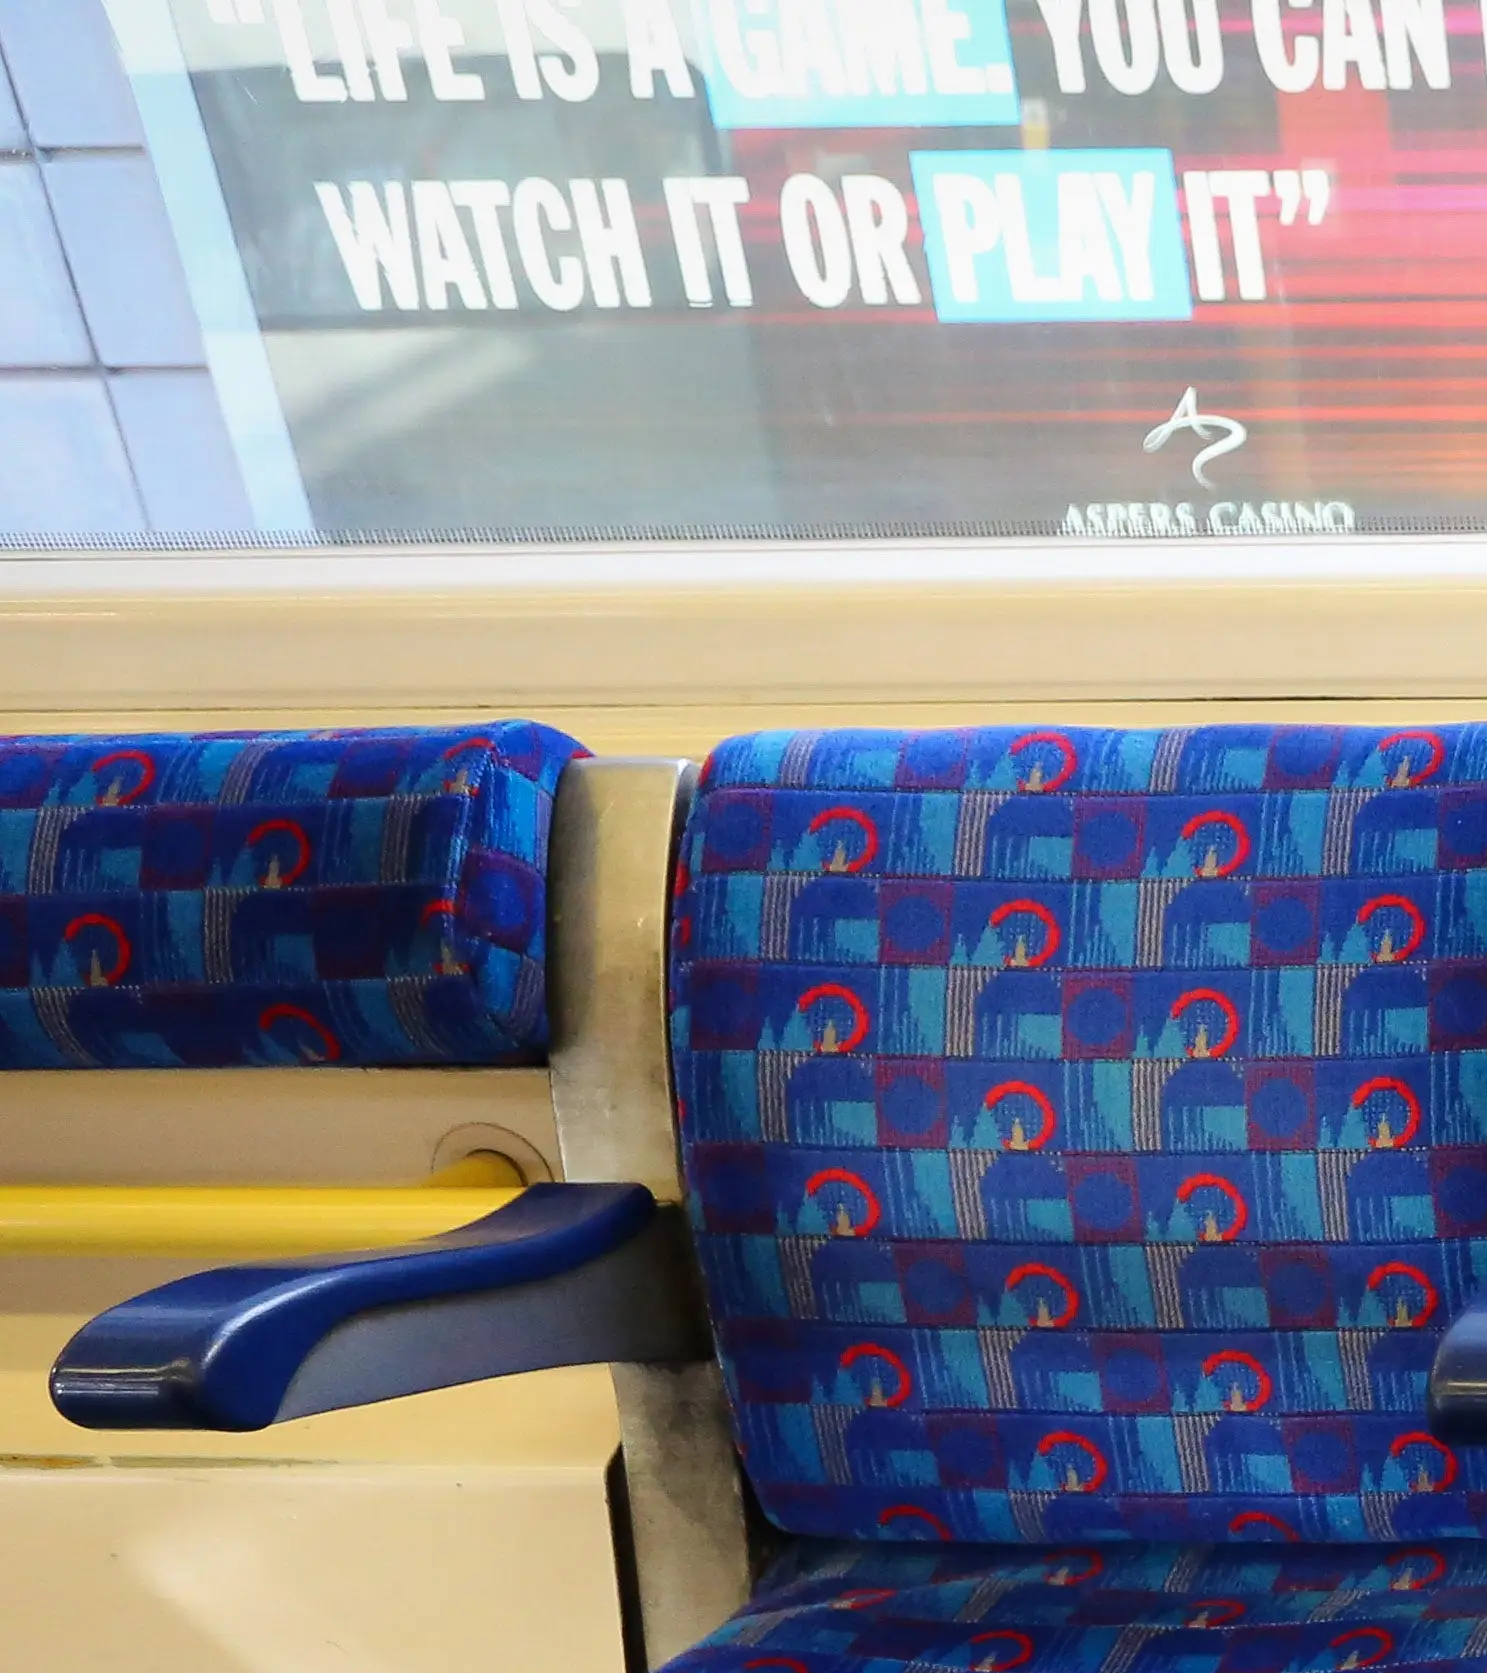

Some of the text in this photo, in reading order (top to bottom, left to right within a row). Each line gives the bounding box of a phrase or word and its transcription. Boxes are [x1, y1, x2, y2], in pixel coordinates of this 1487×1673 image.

[500, 0, 601, 102] IS
[622, 0, 697, 100] A
[708, 0, 1014, 98] GAME.
[1036, 0, 1226, 96] YOU
[1250, 0, 1452, 93] CAN
[314, 170, 1331, 311] WATCH IT OR PLAY IT”
